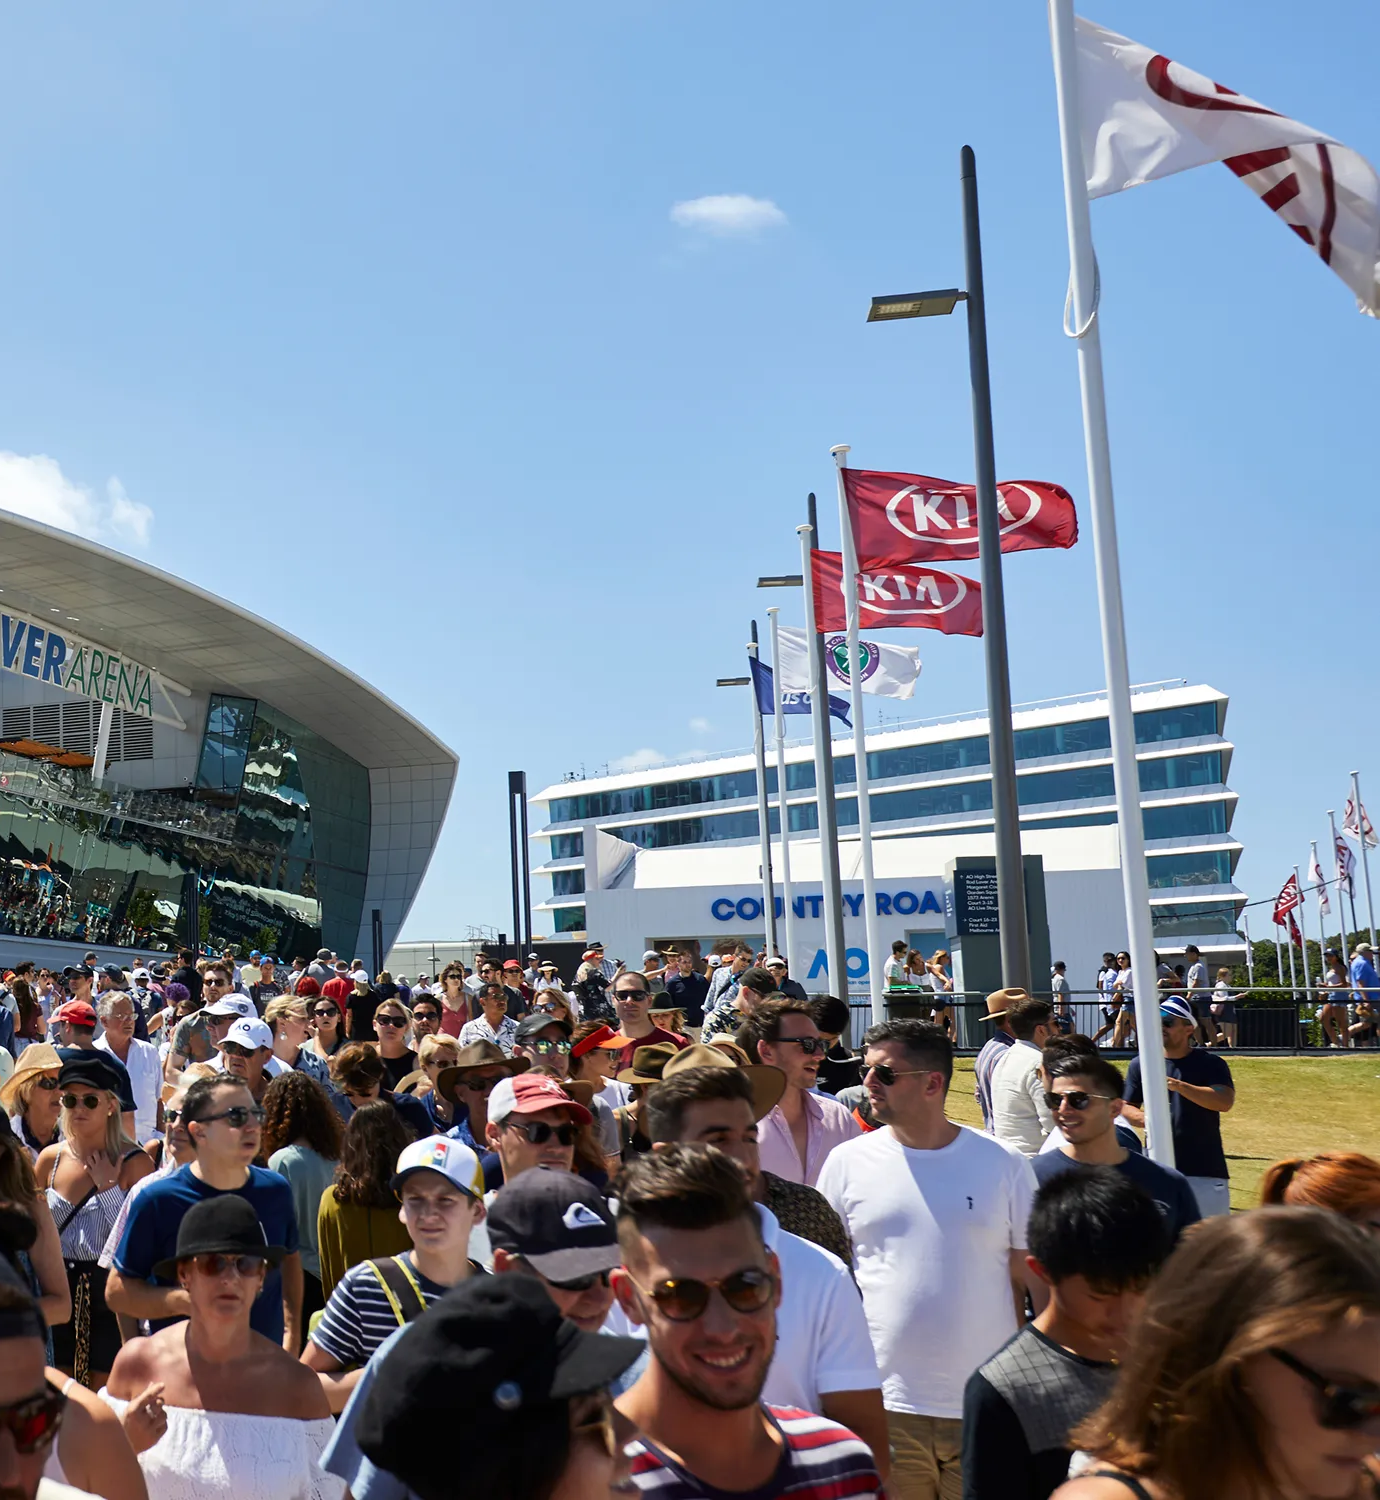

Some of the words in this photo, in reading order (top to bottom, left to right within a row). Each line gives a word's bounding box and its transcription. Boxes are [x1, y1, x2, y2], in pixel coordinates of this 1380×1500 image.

[859, 573, 943, 606] KIA
[64, 645, 154, 717] ARENA
[711, 894, 865, 921] COUNTY
[875, 890, 942, 916] ROA
